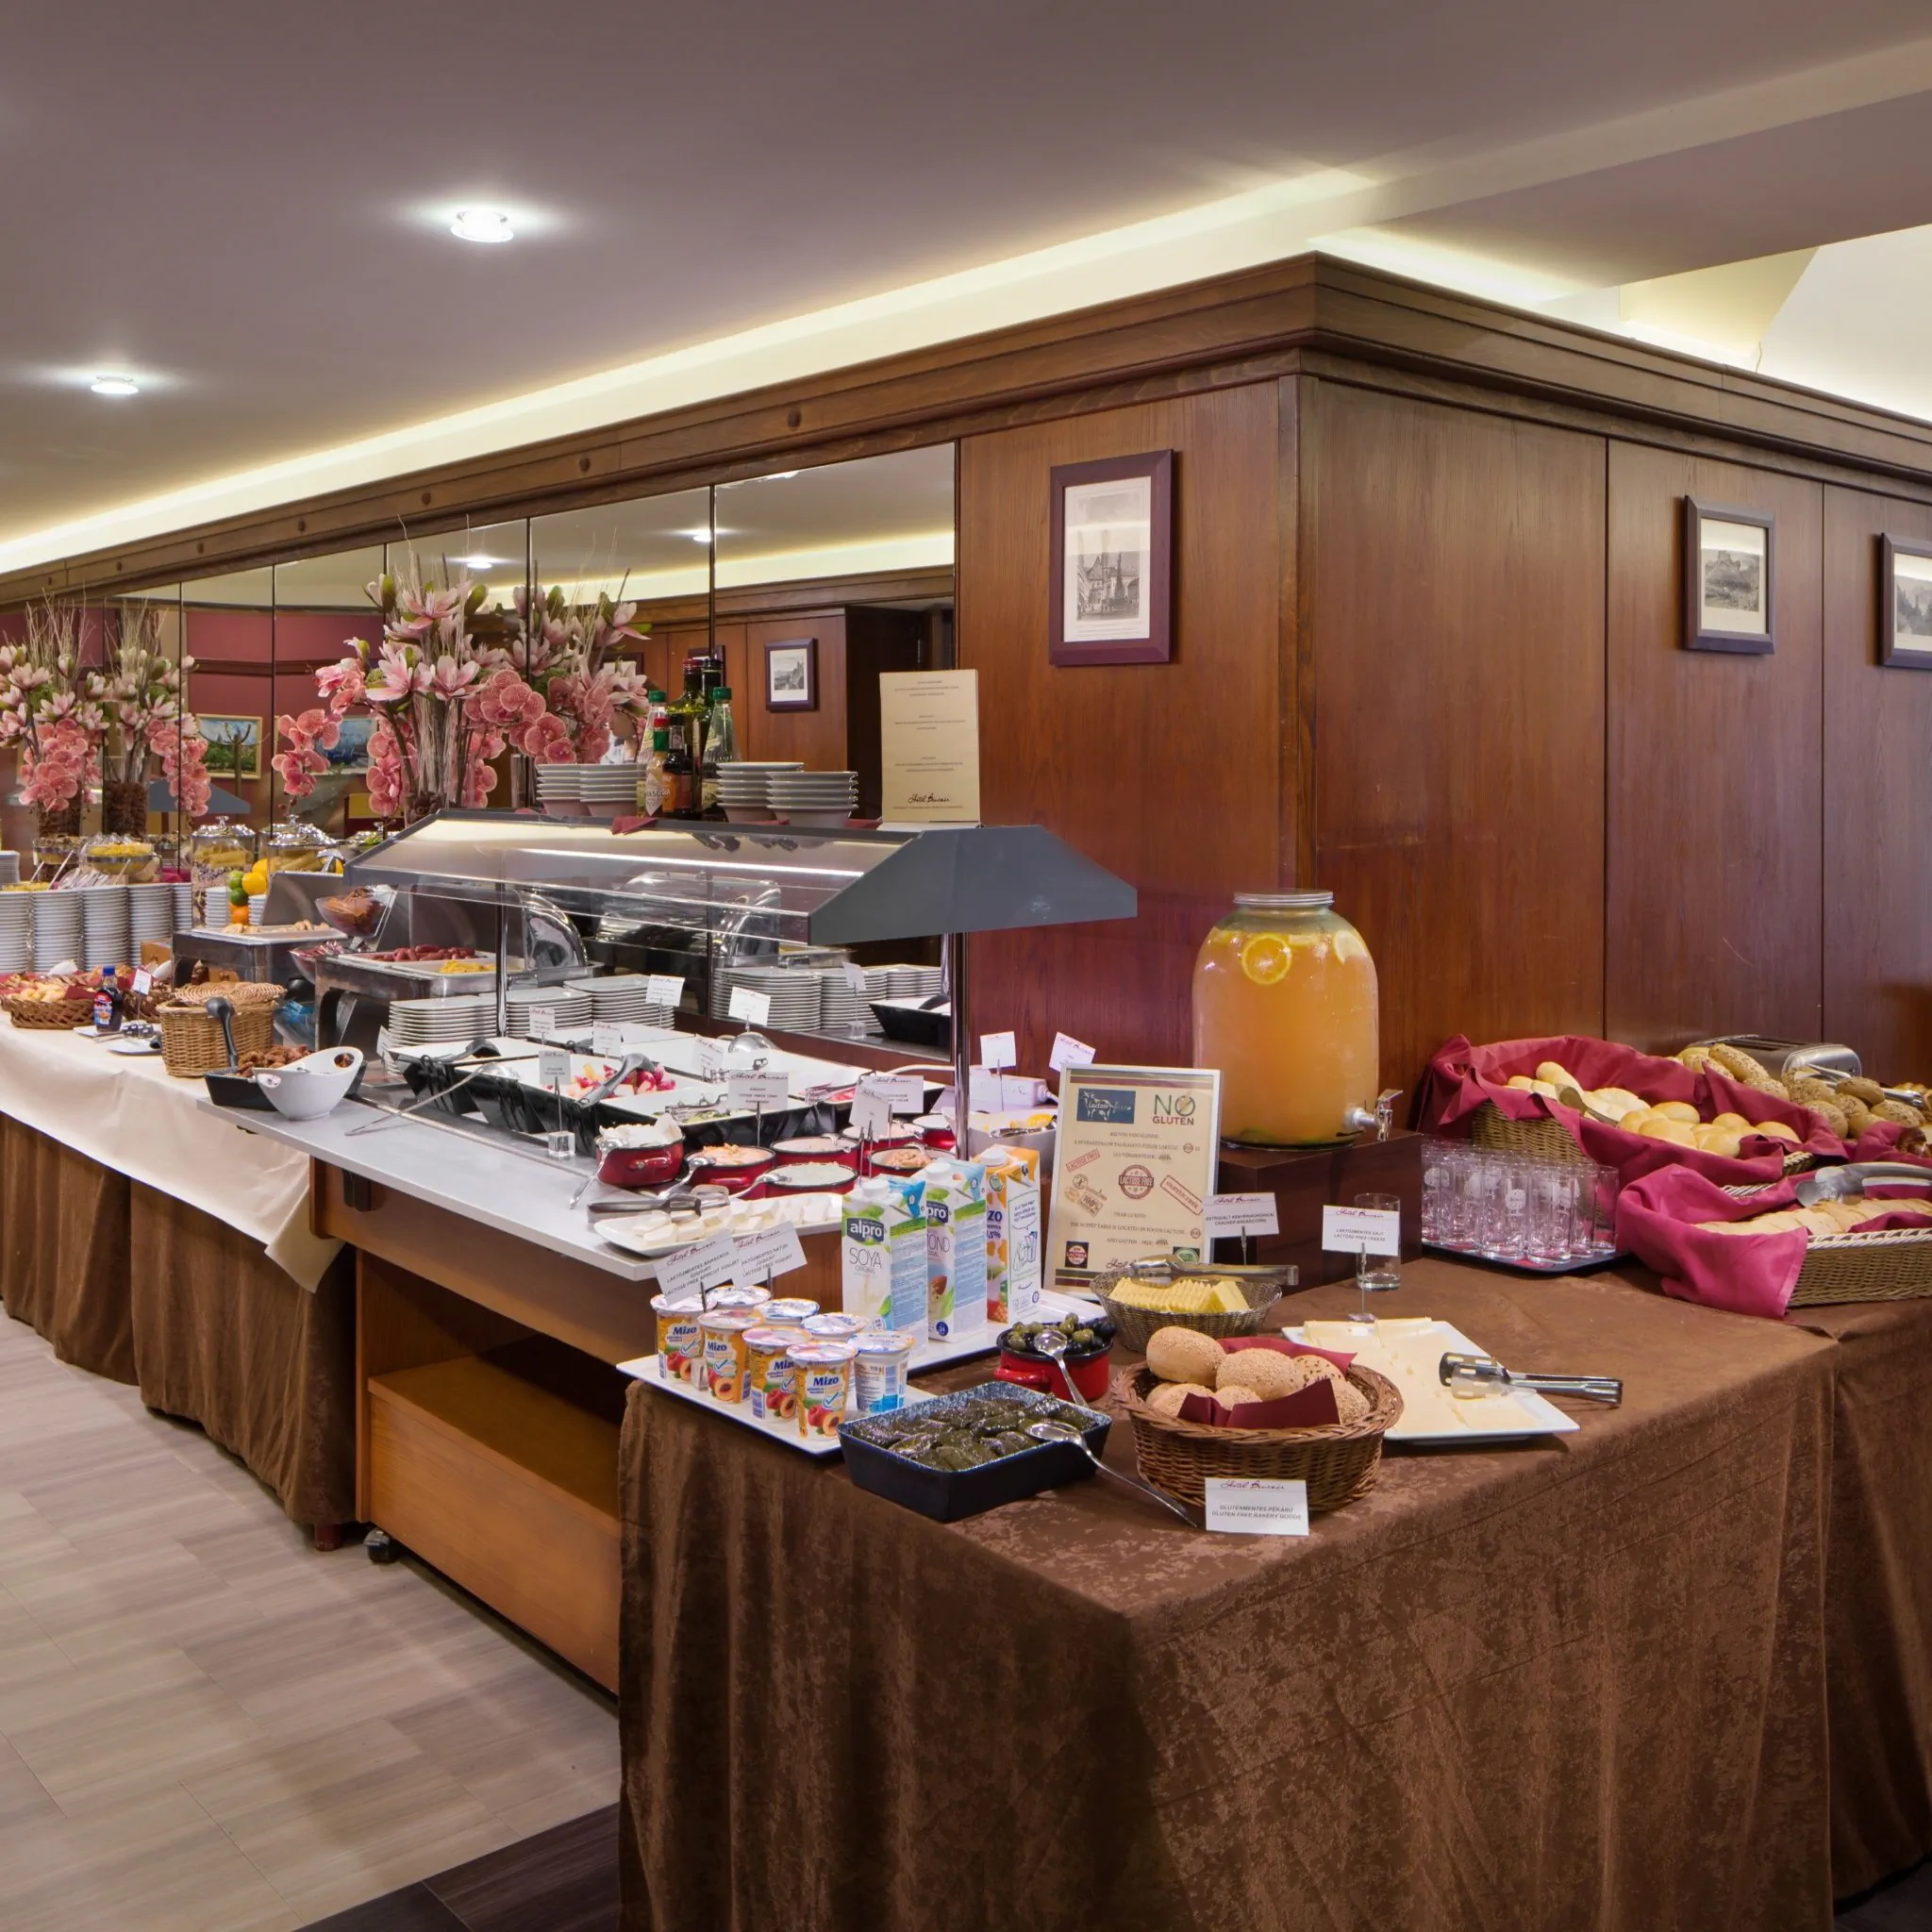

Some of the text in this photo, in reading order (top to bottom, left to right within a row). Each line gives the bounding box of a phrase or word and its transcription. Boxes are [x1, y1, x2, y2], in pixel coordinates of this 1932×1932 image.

[1154, 1094, 1196, 1117] NO
[1153, 1115, 1195, 1125] GLUTEN
[850, 1220, 883, 1239] alpro
[927, 1234, 951, 1253] OND
[849, 1247, 882, 1269] SOYA
[664, 1283, 687, 1297] LACTOSE
[686, 1278, 699, 1289] FREE
[673, 1325, 697, 1336] Mizo
[708, 1341, 728, 1352] Mizo
[774, 1359, 794, 1371] Miz
[813, 1376, 840, 1387] Mizo
